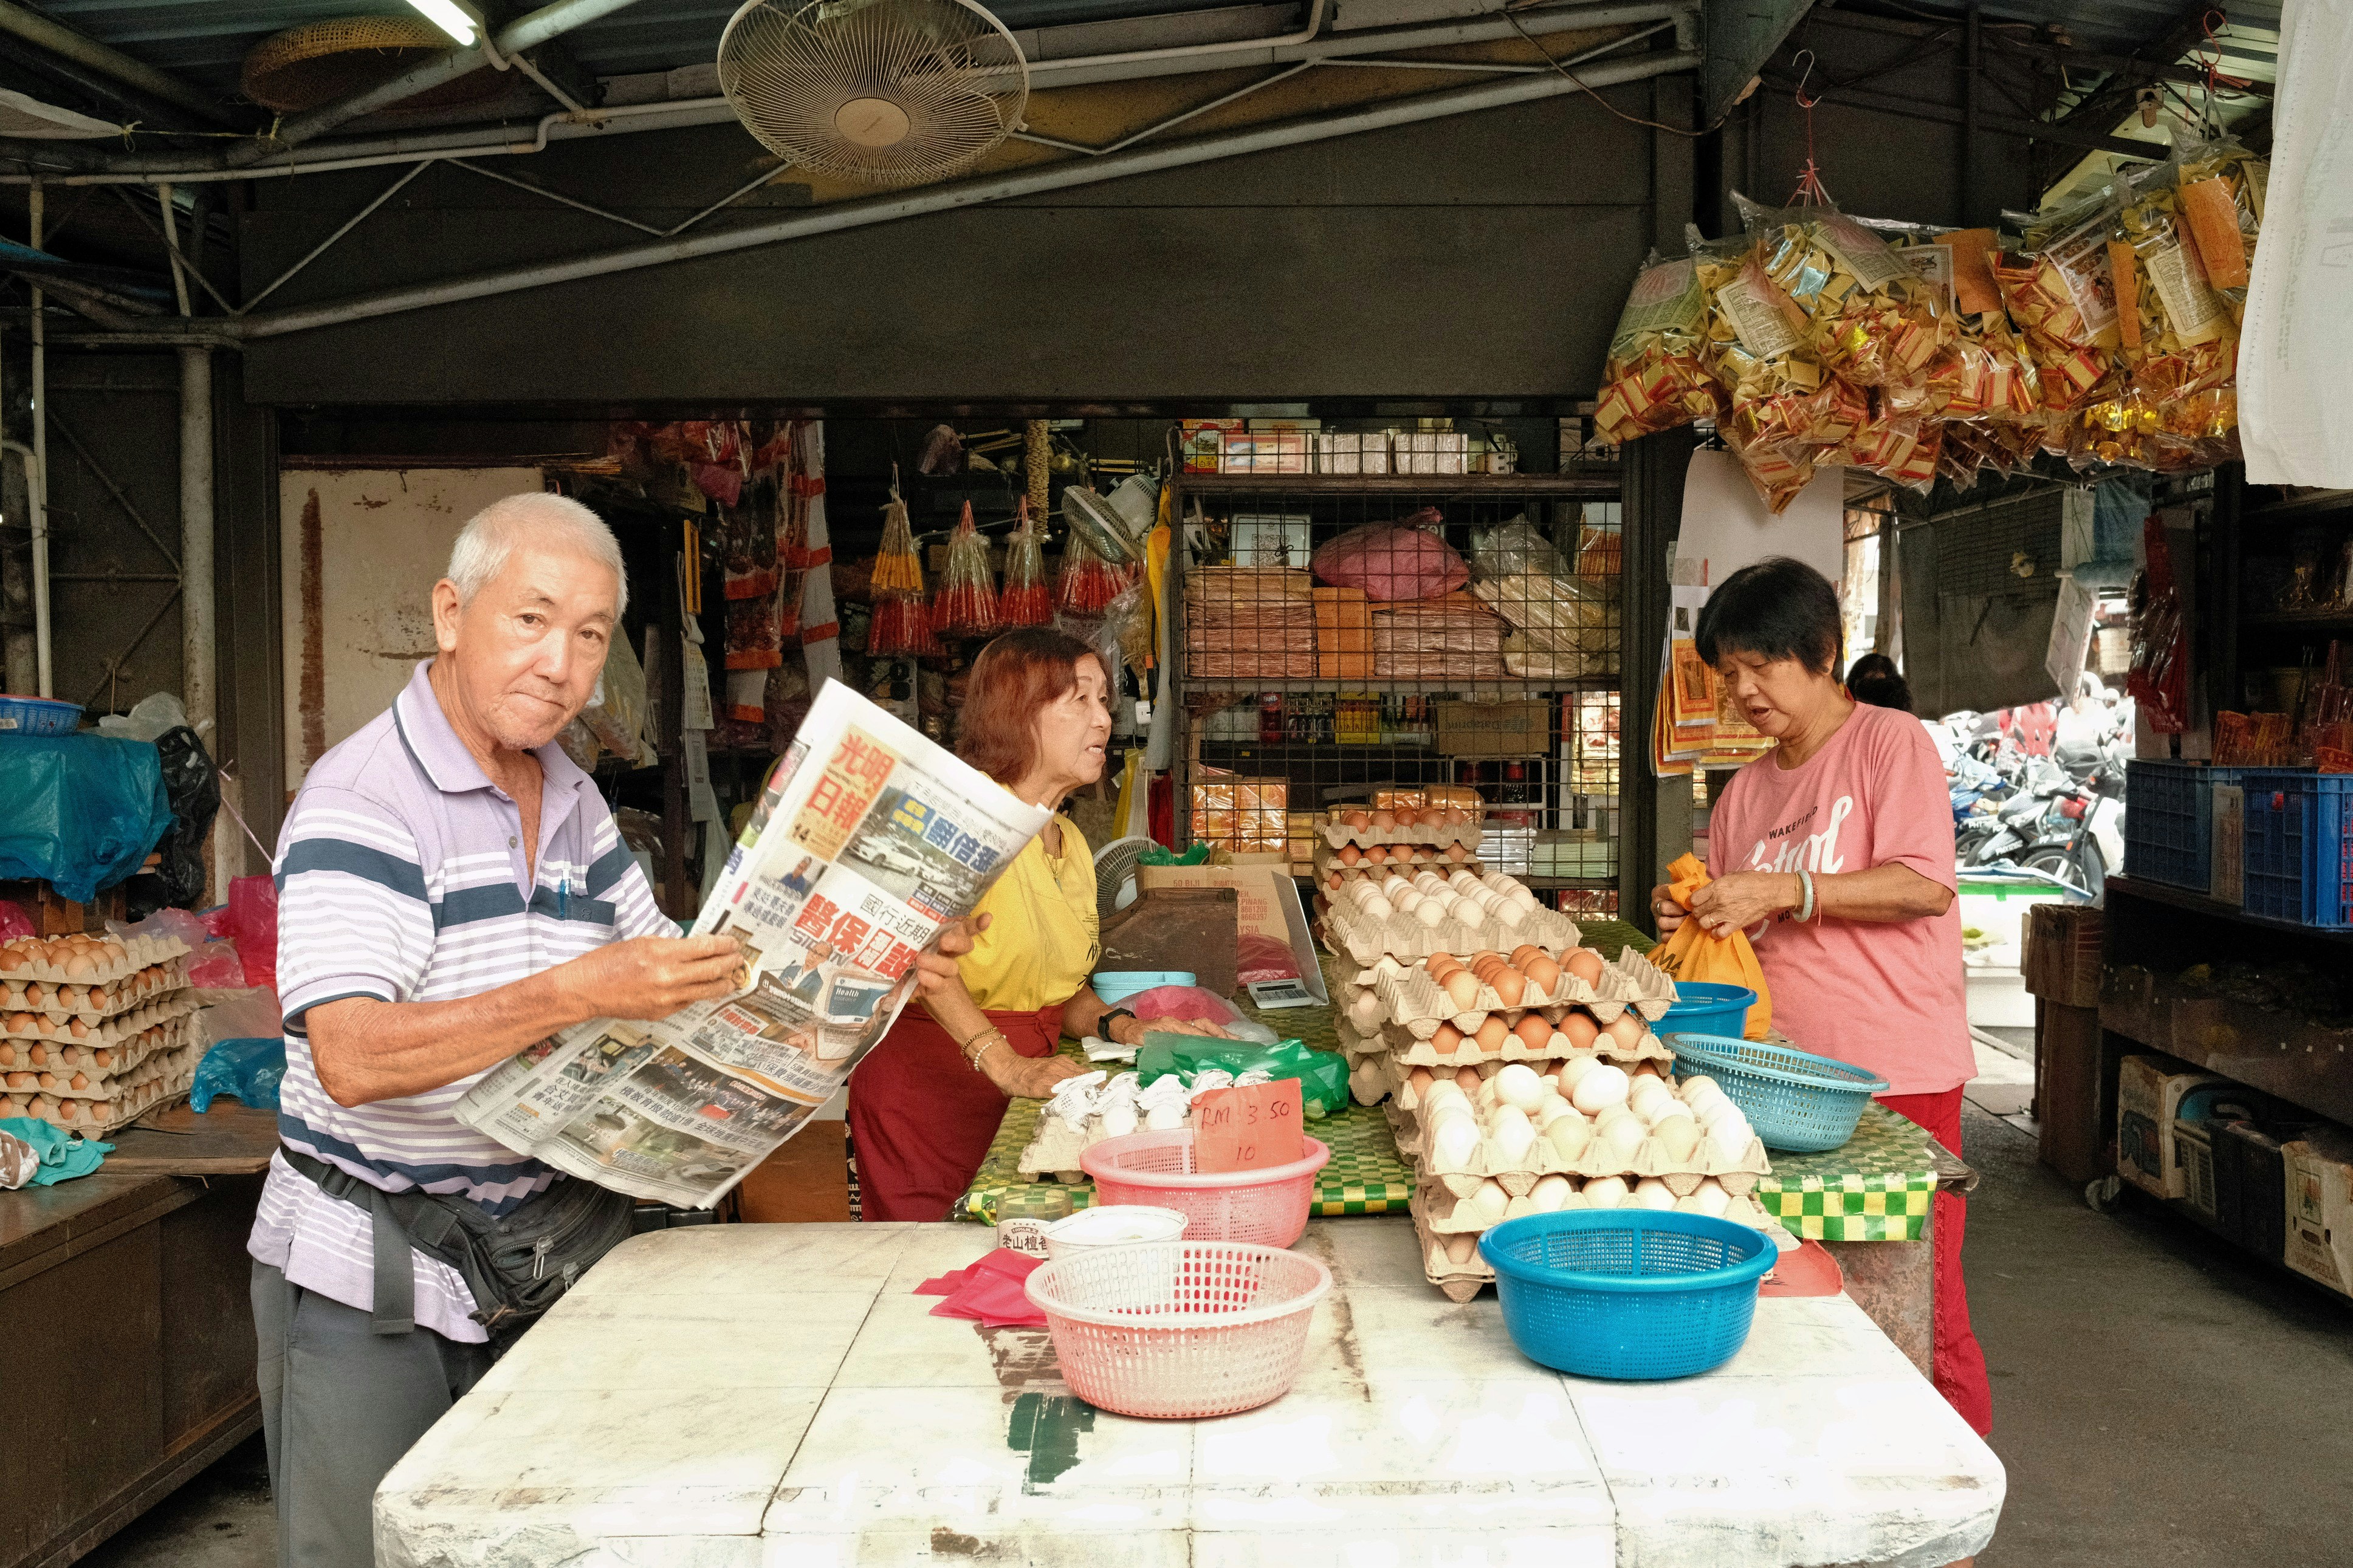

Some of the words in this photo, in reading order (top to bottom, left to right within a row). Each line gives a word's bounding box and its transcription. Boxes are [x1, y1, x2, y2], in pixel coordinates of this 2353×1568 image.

[831, 733, 896, 792] 光明
[805, 774, 868, 831] 日報
[1238, 925, 1260, 934] YSIA
[836, 987, 859, 998] Health
[1202, 1106, 1230, 1130] RM
[1237, 1146, 1256, 1161] 10
